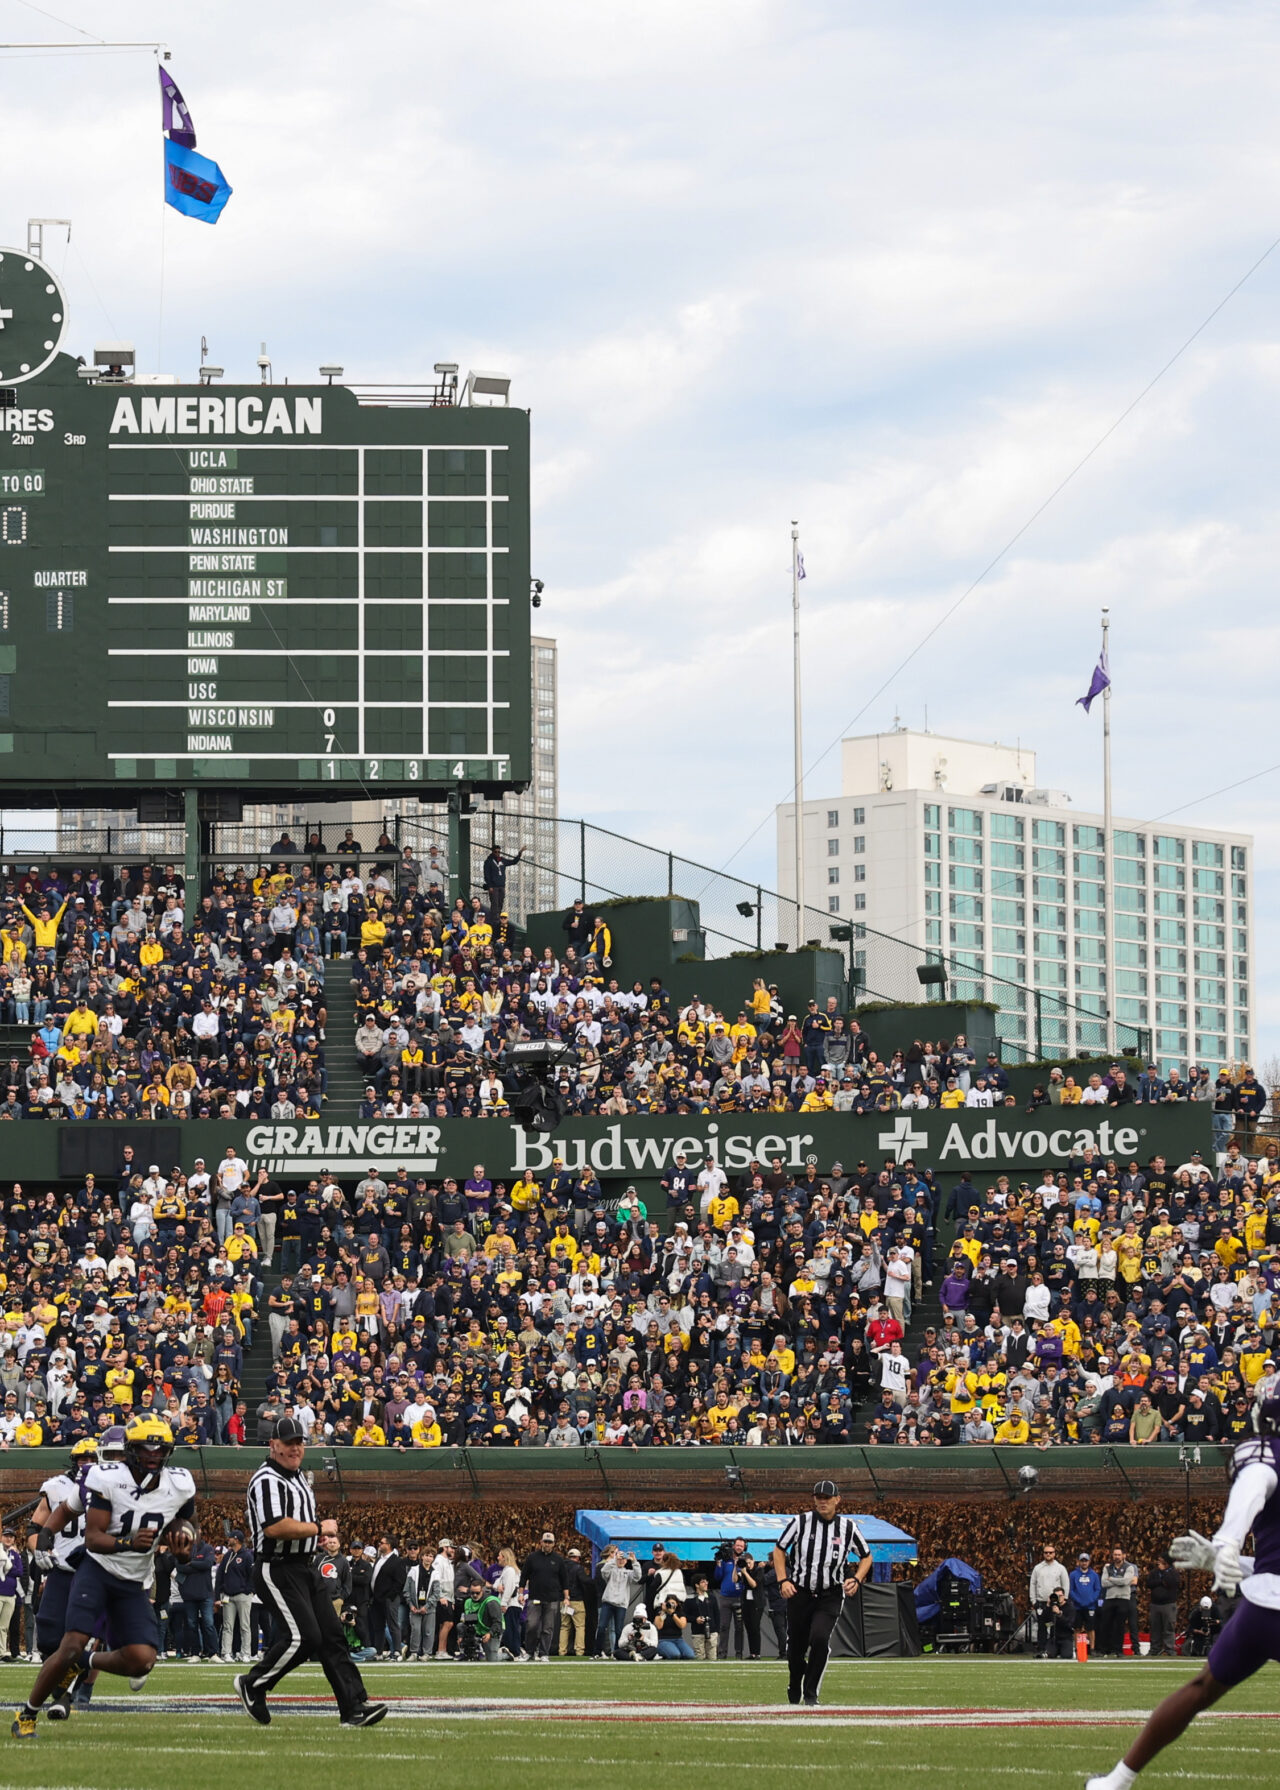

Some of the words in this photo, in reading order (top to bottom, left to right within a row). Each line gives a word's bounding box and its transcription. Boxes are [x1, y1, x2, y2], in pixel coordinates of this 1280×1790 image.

[109, 397, 322, 434] AMERICAN
[12, 432, 35, 445] 2ND
[64, 432, 87, 446] 3RD
[189, 451, 227, 468] UCLA
[2, 475, 19, 493] TO
[24, 474, 43, 492] GO
[190, 477, 217, 494] OHIO
[219, 477, 253, 494] STATE
[190, 503, 235, 519] PURDUE
[190, 528, 288, 545] WASHINGTON
[190, 555, 219, 571] PENN
[221, 555, 256, 571] STATE
[34, 571, 87, 587] QUARTER
[189, 580, 261, 597] MICHIGAN
[267, 579, 285, 597] ST
[189, 605, 250, 622] MARYLAND
[188, 632, 233, 648] ILLINOIS
[187, 657, 218, 674] IOWA
[188, 682, 217, 700] USC
[189, 707, 274, 726] WISCONSIN
[323, 708, 336, 727] 0
[187, 735, 232, 751] INDIANA
[323, 734, 336, 754] 7
[326, 760, 336, 779] 1
[369, 760, 379, 779] 2
[409, 760, 418, 779] 3
[452, 760, 464, 779] 4
[497, 760, 507, 780] F
[245, 1125, 441, 1156] GRAINGER
[510, 1122, 811, 1172] Budweiser
[939, 1119, 1138, 1160] Advocate
[673, 1176, 686, 1190] 84
[284, 1209, 297, 1220] M
[586, 1334, 596, 1349] 2
[889, 1359, 901, 1375] 10
